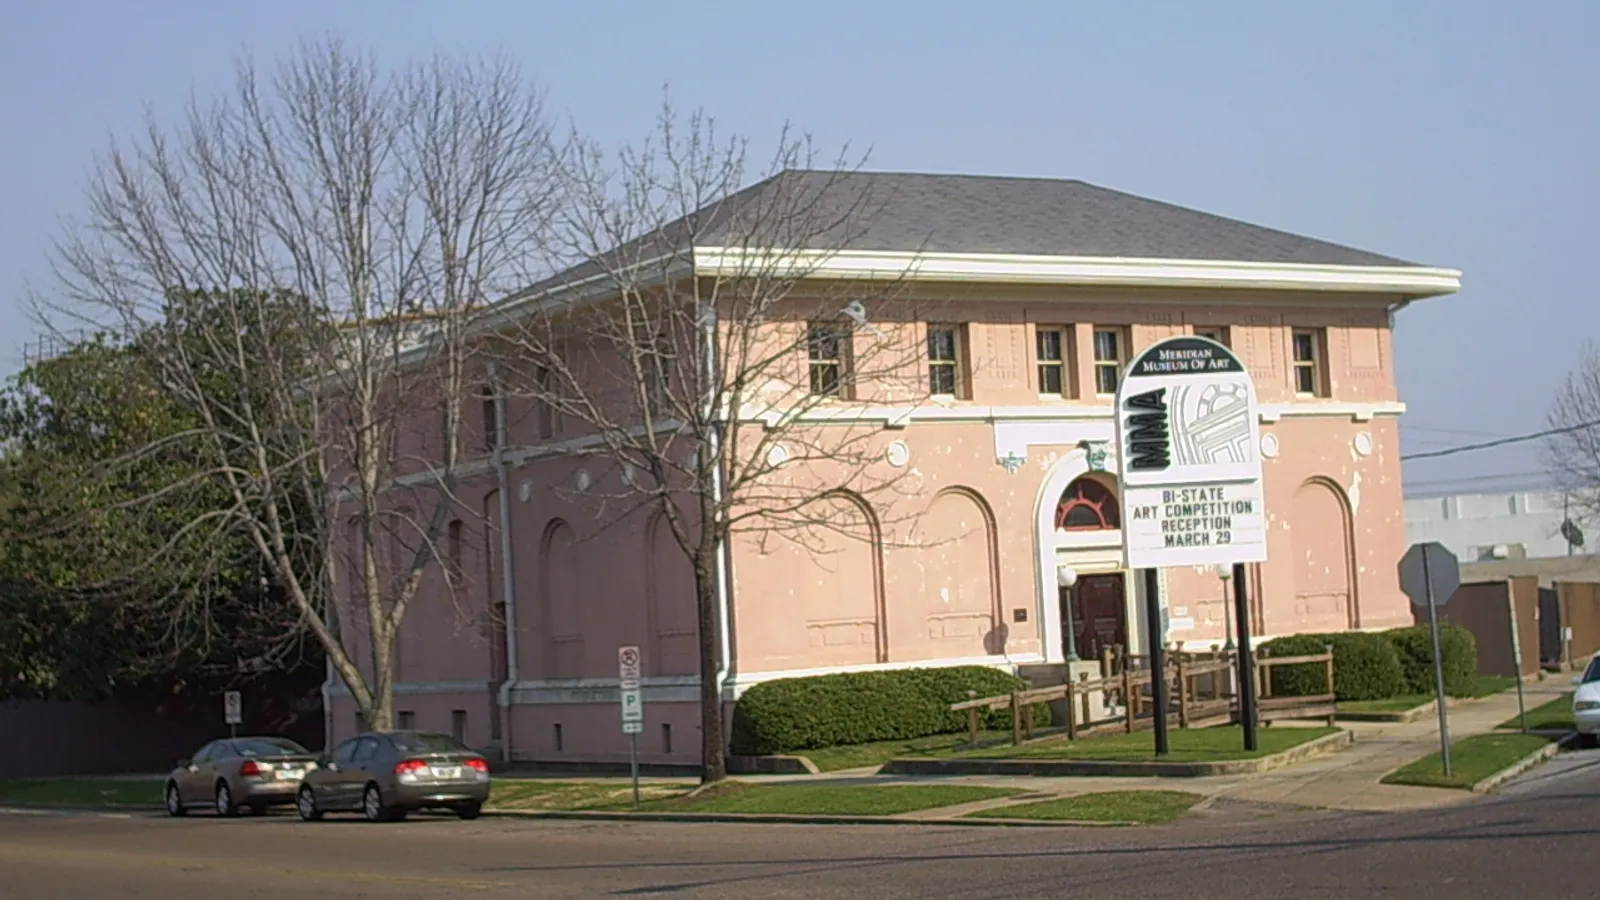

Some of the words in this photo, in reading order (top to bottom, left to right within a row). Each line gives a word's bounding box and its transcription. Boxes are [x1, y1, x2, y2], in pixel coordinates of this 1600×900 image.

[1159, 348, 1213, 360] MERIDIAN
[1142, 360, 1188, 372] MUSEUM
[1208, 358, 1230, 370] ART
[1123, 386, 1171, 473] MMA
[1162, 487, 1224, 503] BI-STATE
[1133, 505, 1158, 520] ART
[1165, 500, 1253, 518] COMPETITION
[1161, 516, 1232, 532] RECEPTION
[1164, 532, 1210, 548] MARCH
[1216, 531, 1232, 545] 29
[626, 694, 636, 706] P
